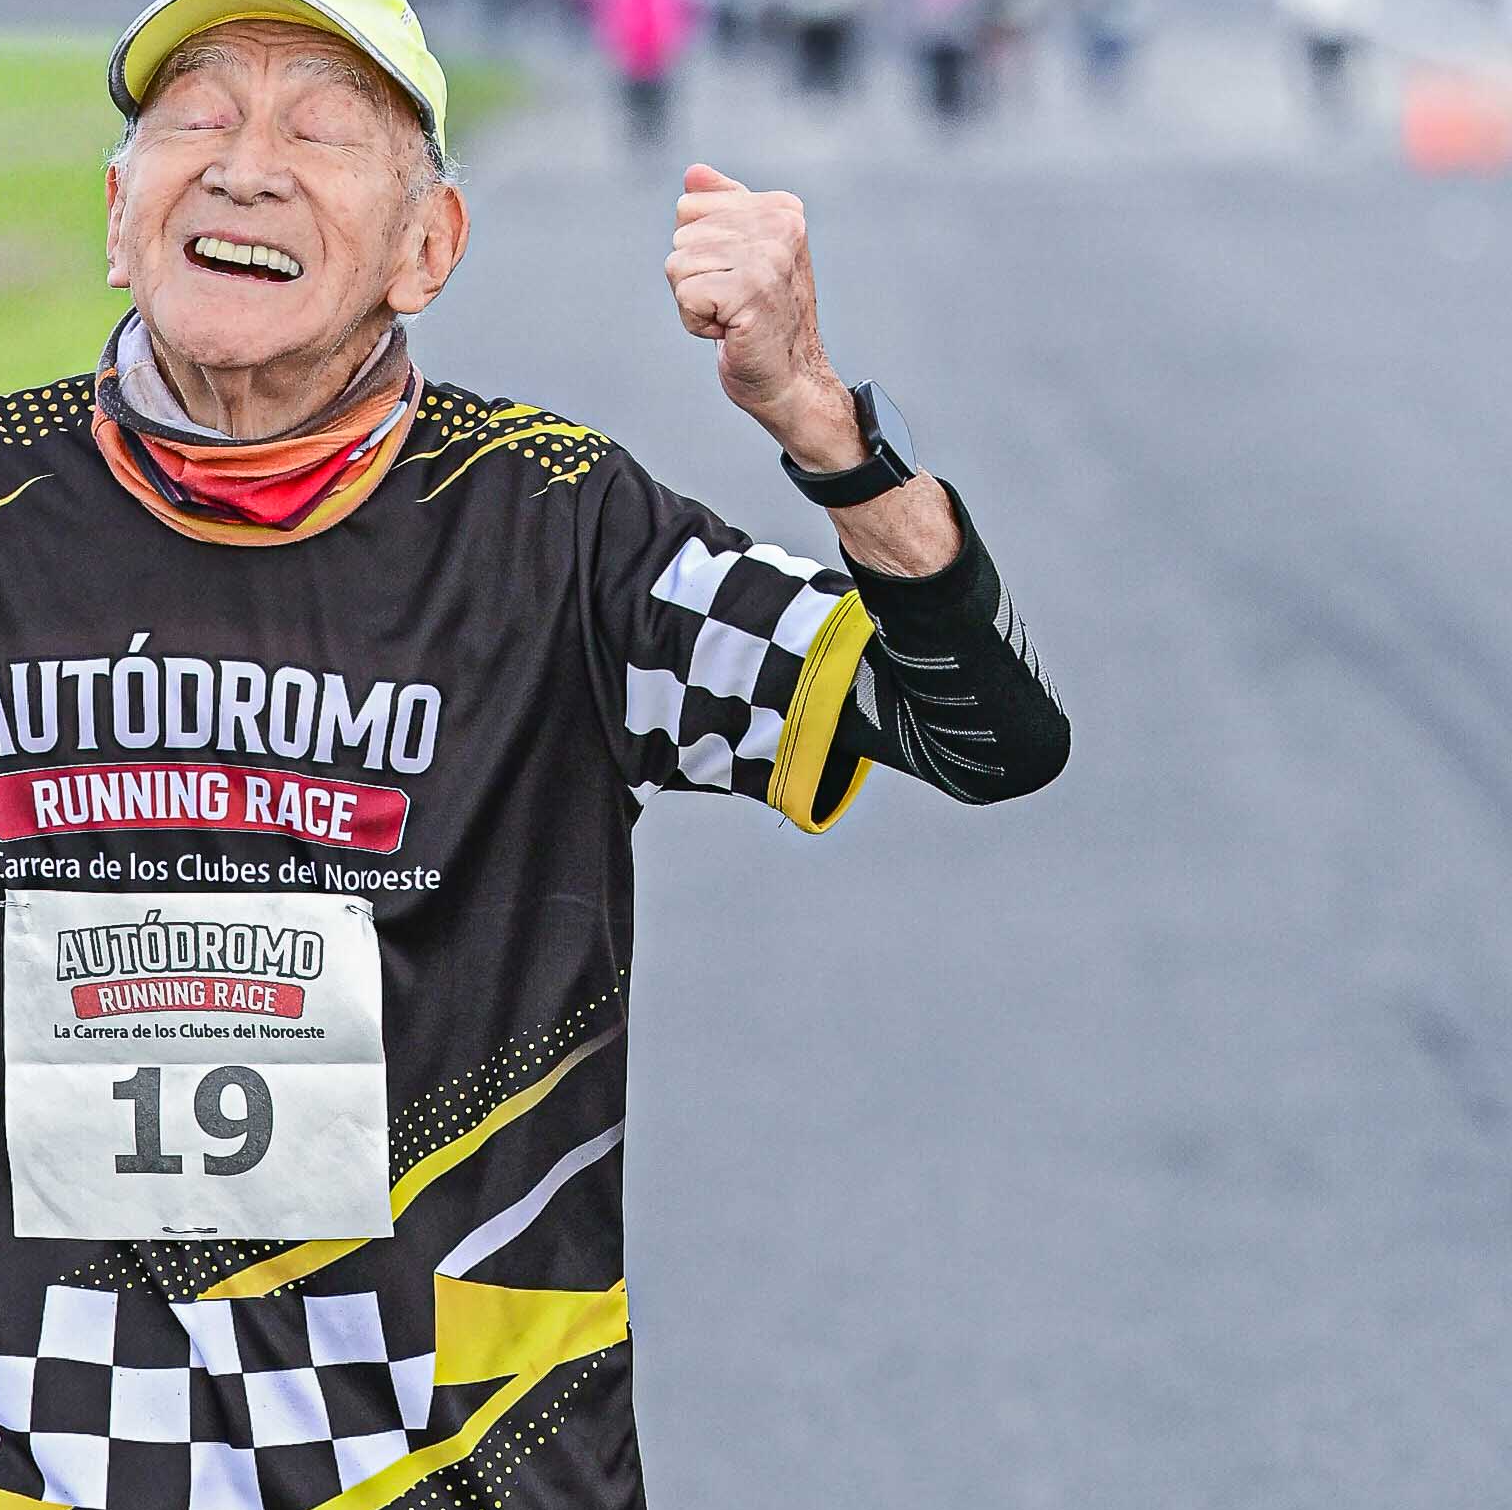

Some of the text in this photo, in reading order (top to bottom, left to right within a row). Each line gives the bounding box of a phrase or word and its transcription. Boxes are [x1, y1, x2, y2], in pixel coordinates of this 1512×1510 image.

[32, 771, 359, 843] RUNNING RACE
[89, 852, 122, 879] de
[130, 852, 169, 881] los
[176, 853, 270, 883] Clubes
[278, 856, 317, 884] del
[325, 863, 441, 891] Noroeste
[56, 909, 323, 981] AUTÓDROMO
[99, 980, 277, 1013] RUNNING RACE
[54, 1023, 325, 1039] La Carrera de los Clubes del Noroeste
[112, 1065, 274, 1176] 19
